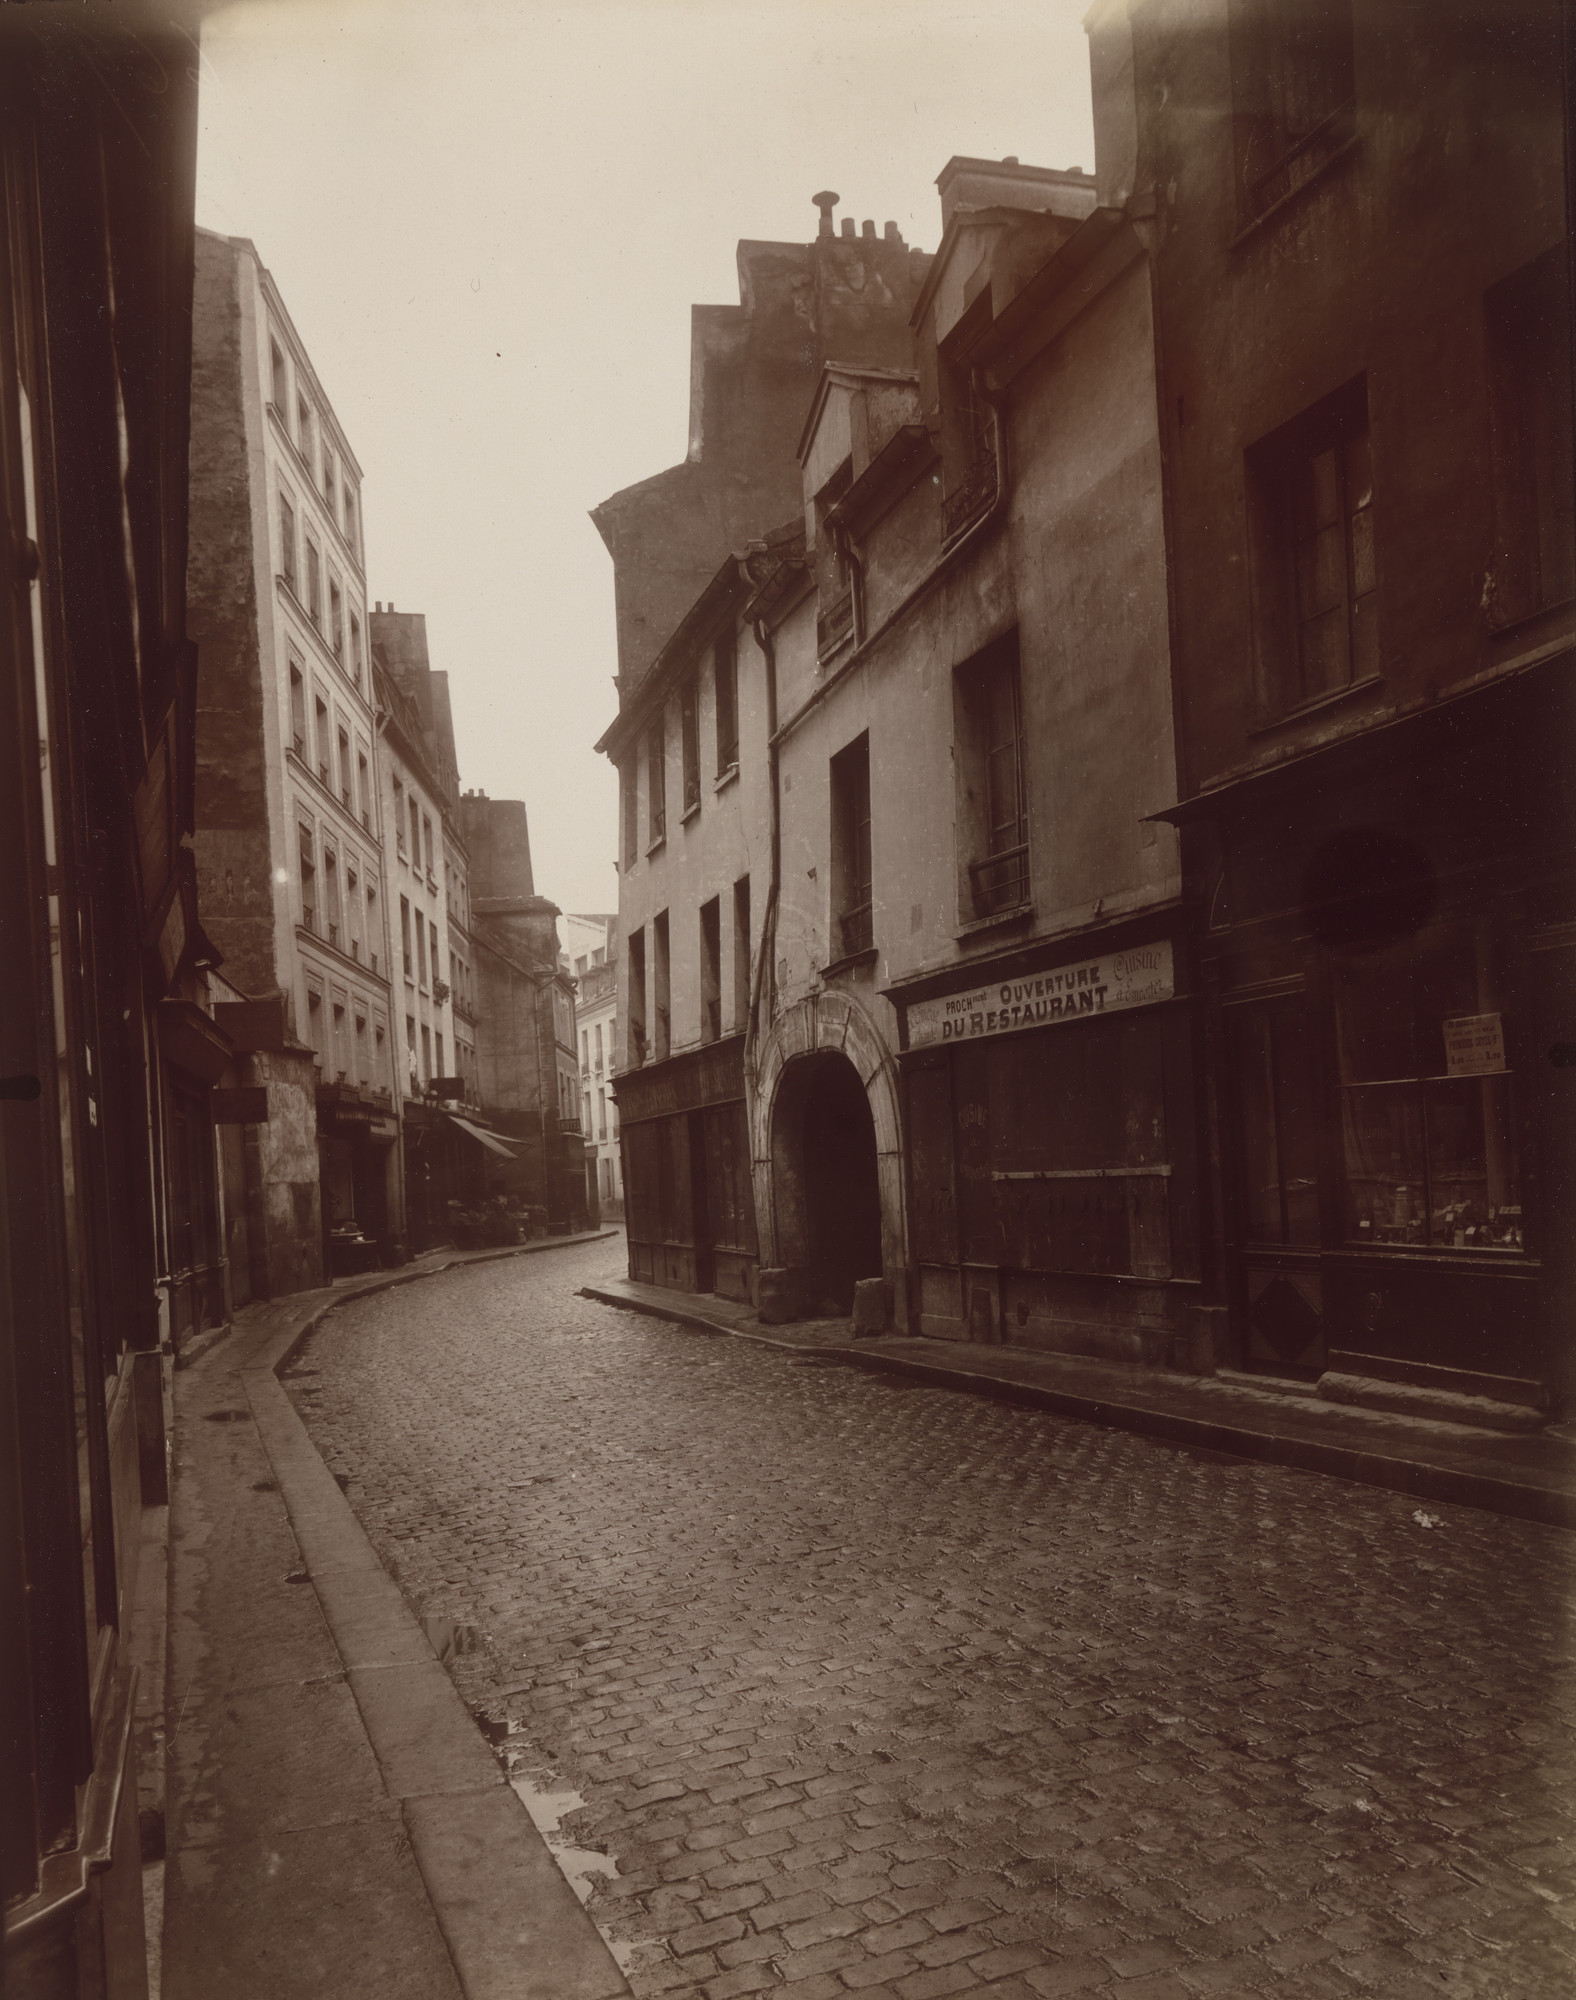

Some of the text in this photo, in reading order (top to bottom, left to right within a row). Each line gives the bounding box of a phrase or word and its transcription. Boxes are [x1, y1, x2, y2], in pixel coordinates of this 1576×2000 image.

[1000, 966, 1100, 1005] OUVERTURE
[1113, 951, 1161, 981] Cuisine
[942, 1017, 965, 1040] DU
[969, 985, 1108, 1036] RESTAURANT
